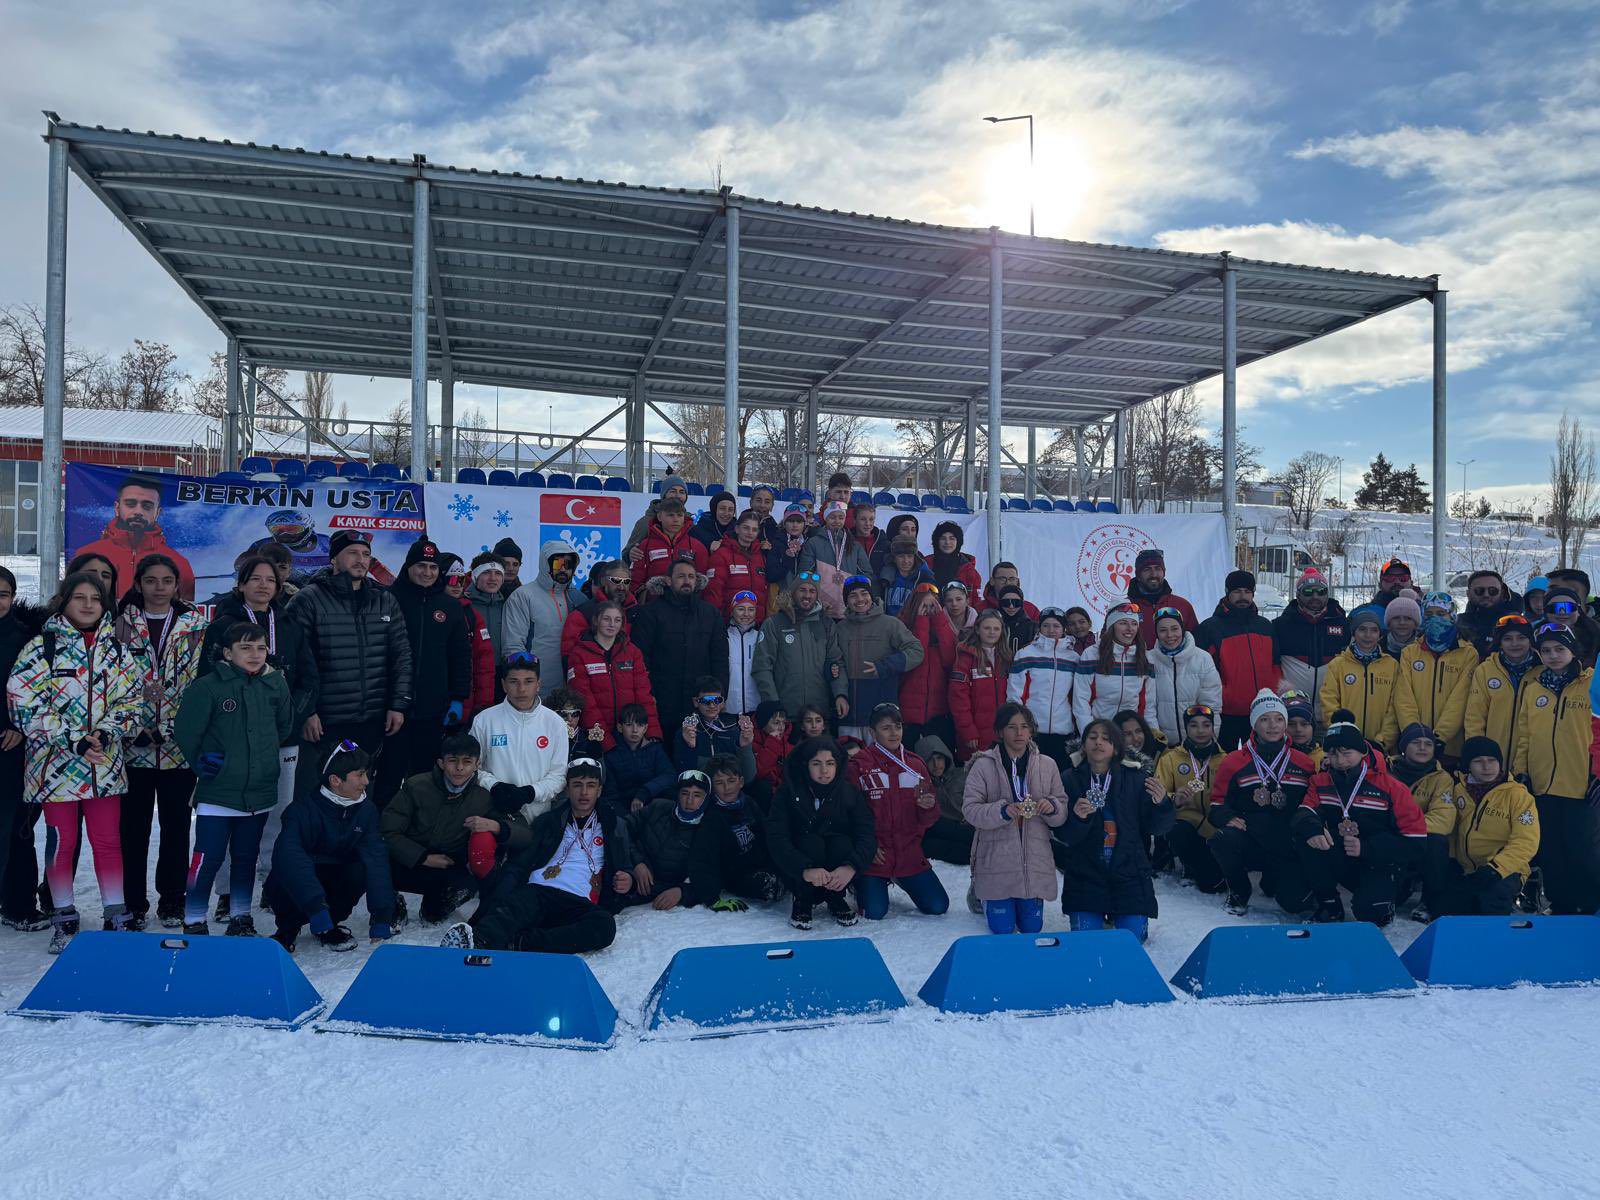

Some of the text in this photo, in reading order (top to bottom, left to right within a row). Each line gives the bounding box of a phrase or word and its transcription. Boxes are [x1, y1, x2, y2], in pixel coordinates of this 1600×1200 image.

[178, 481, 419, 512] BERKİN USTA
[335, 516, 425, 531] KAYAK SEZONU
